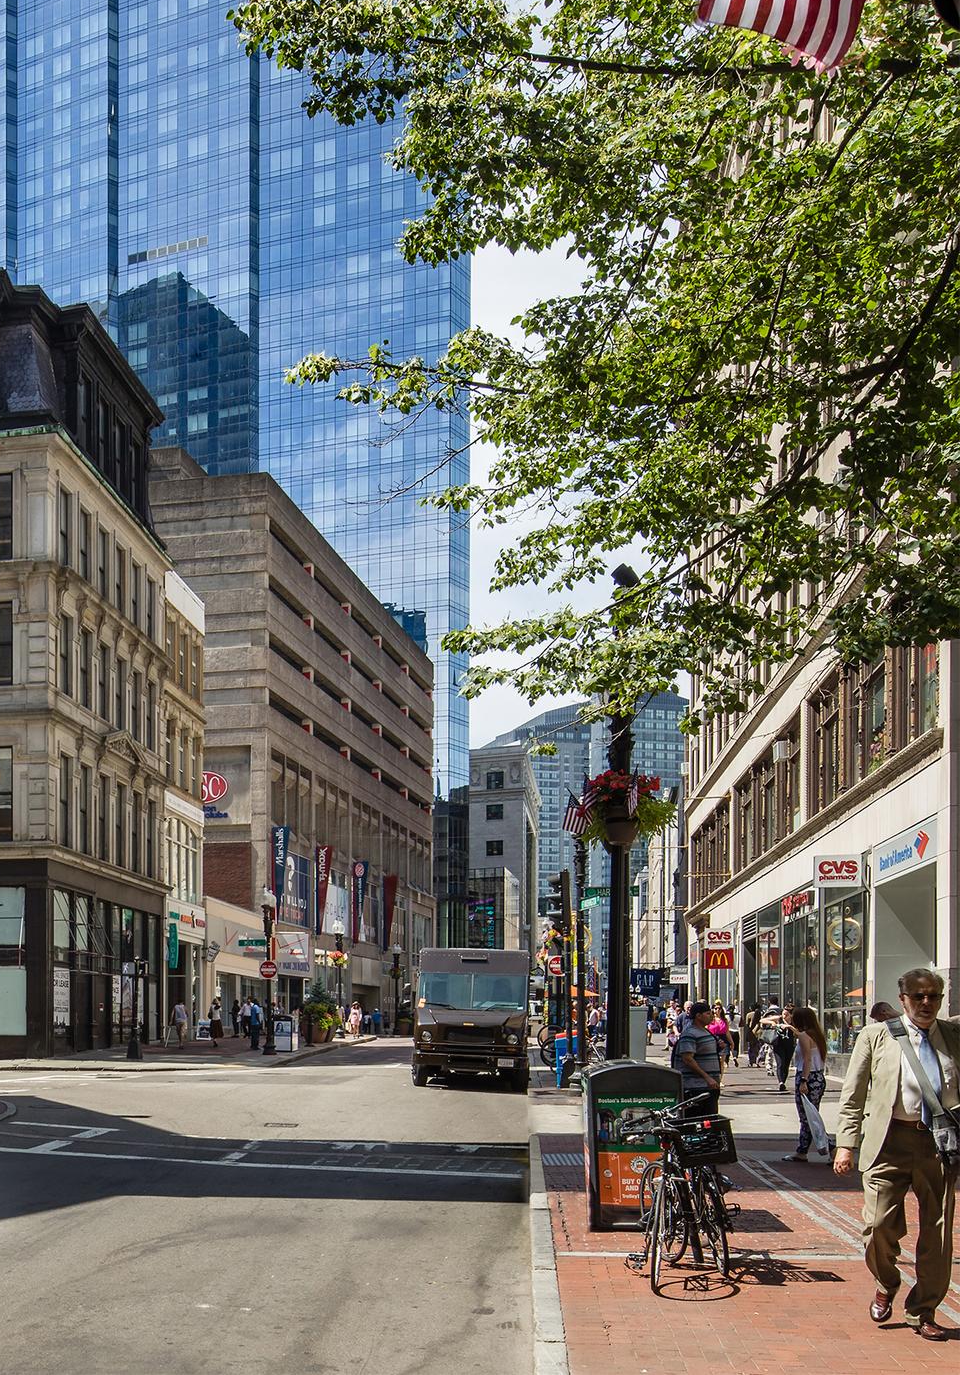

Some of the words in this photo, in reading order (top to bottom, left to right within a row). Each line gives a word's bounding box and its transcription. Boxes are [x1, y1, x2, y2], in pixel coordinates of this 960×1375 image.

[275, 828, 284, 866] Marshalls
[880, 853, 891, 871] Bank
[895, 845, 912, 864] America
[818, 860, 858, 874] CVS
[708, 931, 731, 940] CVS
[637, 975, 654, 986] GAP
